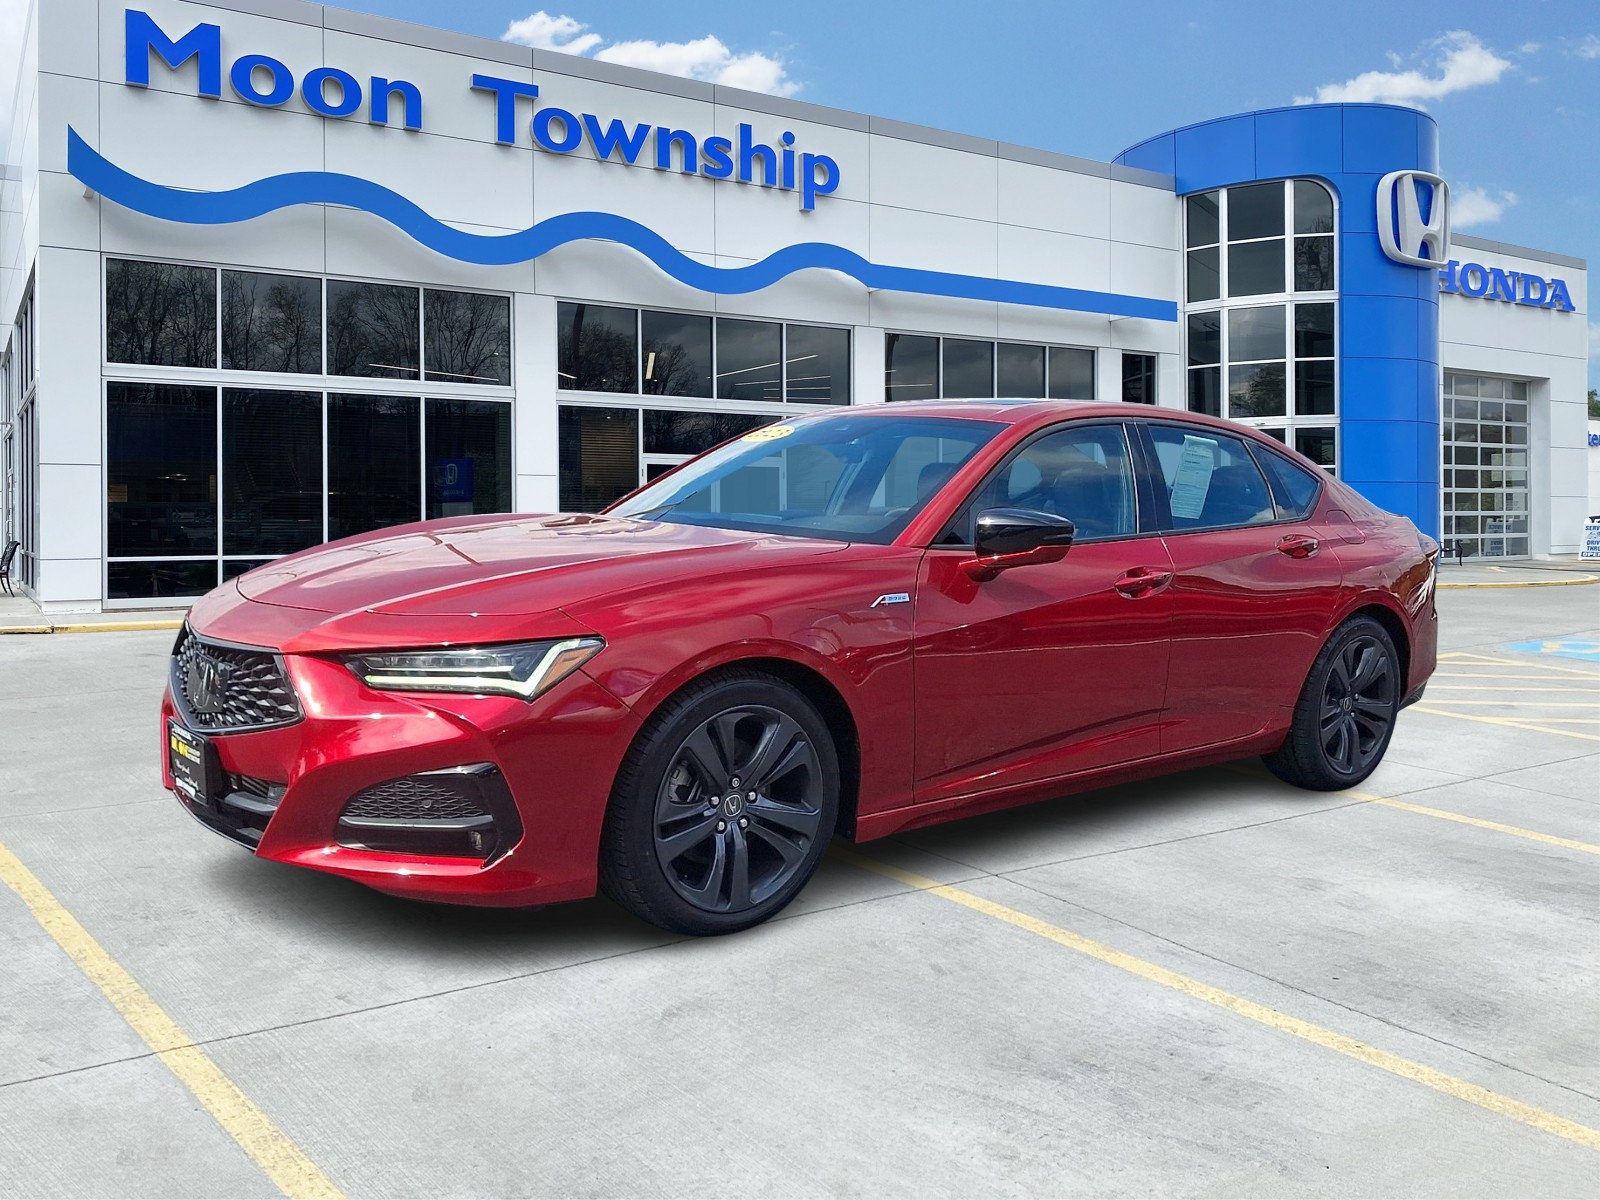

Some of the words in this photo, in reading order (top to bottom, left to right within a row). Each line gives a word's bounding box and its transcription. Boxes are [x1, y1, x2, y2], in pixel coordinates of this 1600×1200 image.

[124, 9, 423, 132] Moon
[470, 73, 841, 212] Township
[1439, 259, 1576, 312] HONDA
